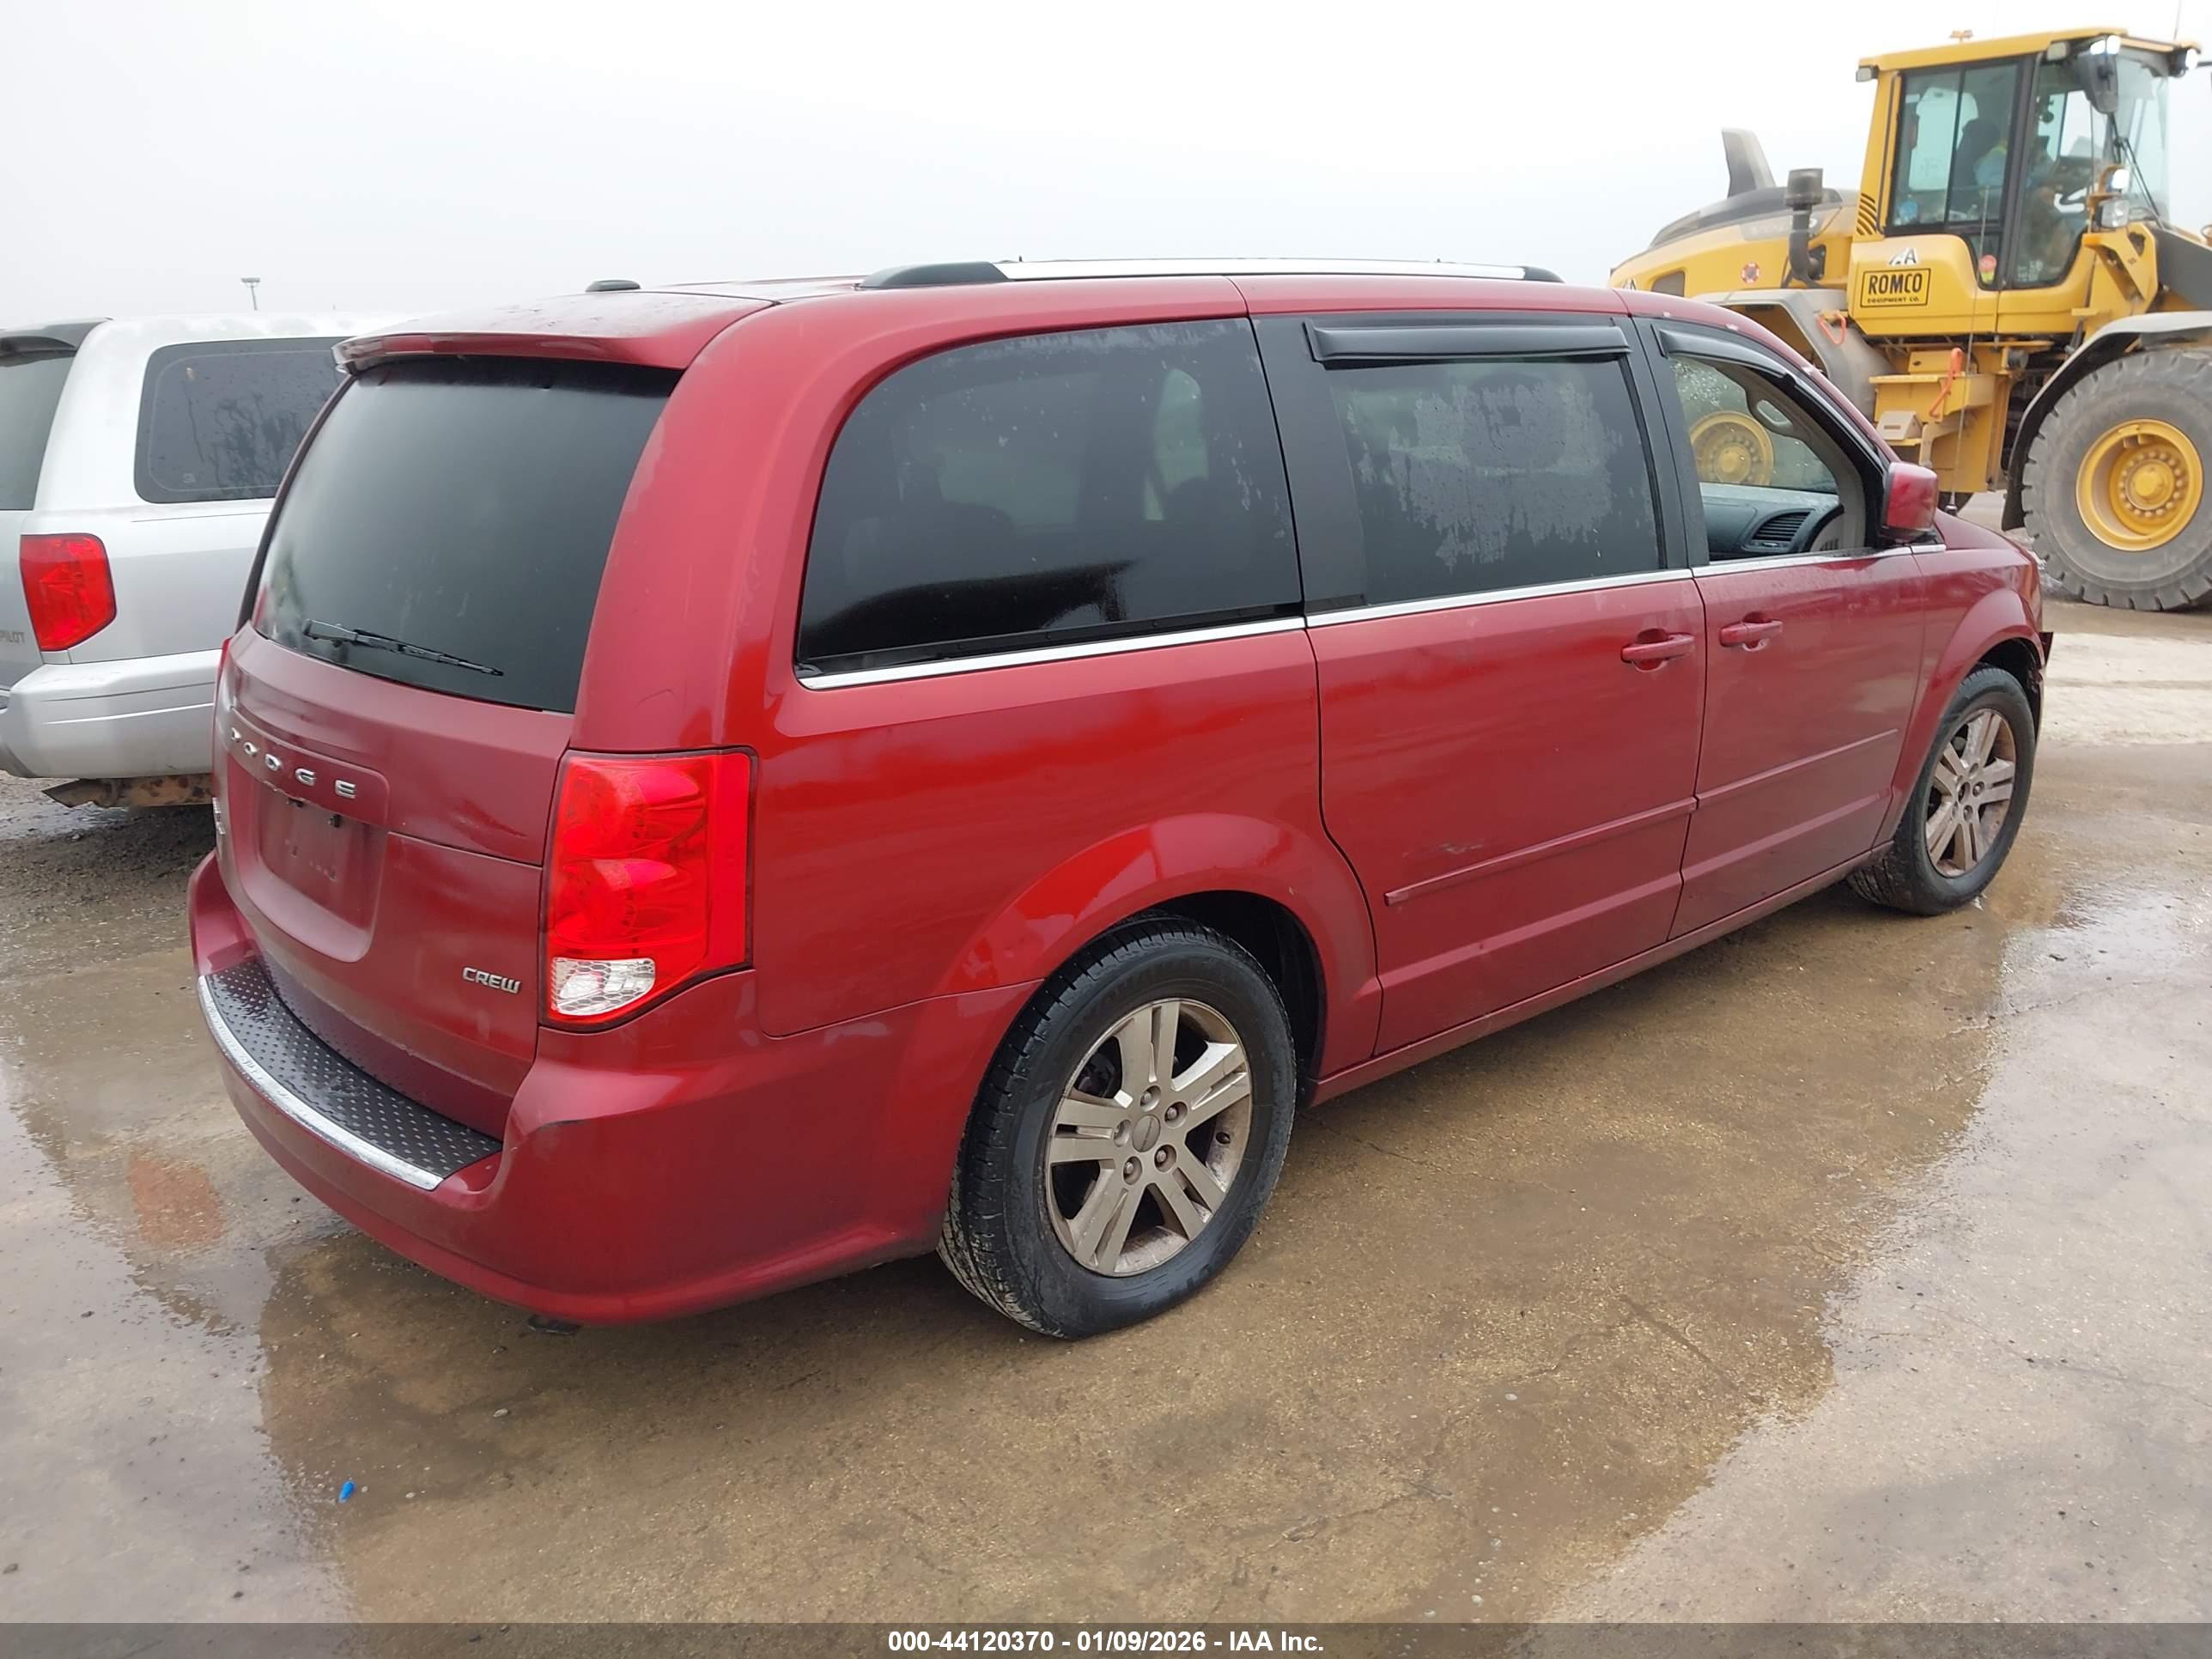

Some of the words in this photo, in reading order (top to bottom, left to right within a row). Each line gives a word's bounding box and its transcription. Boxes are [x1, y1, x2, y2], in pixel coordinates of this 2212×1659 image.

[1869, 273, 1923, 295] ROMCO
[231, 727, 356, 799] DODGE
[462, 967, 521, 994] CREW
